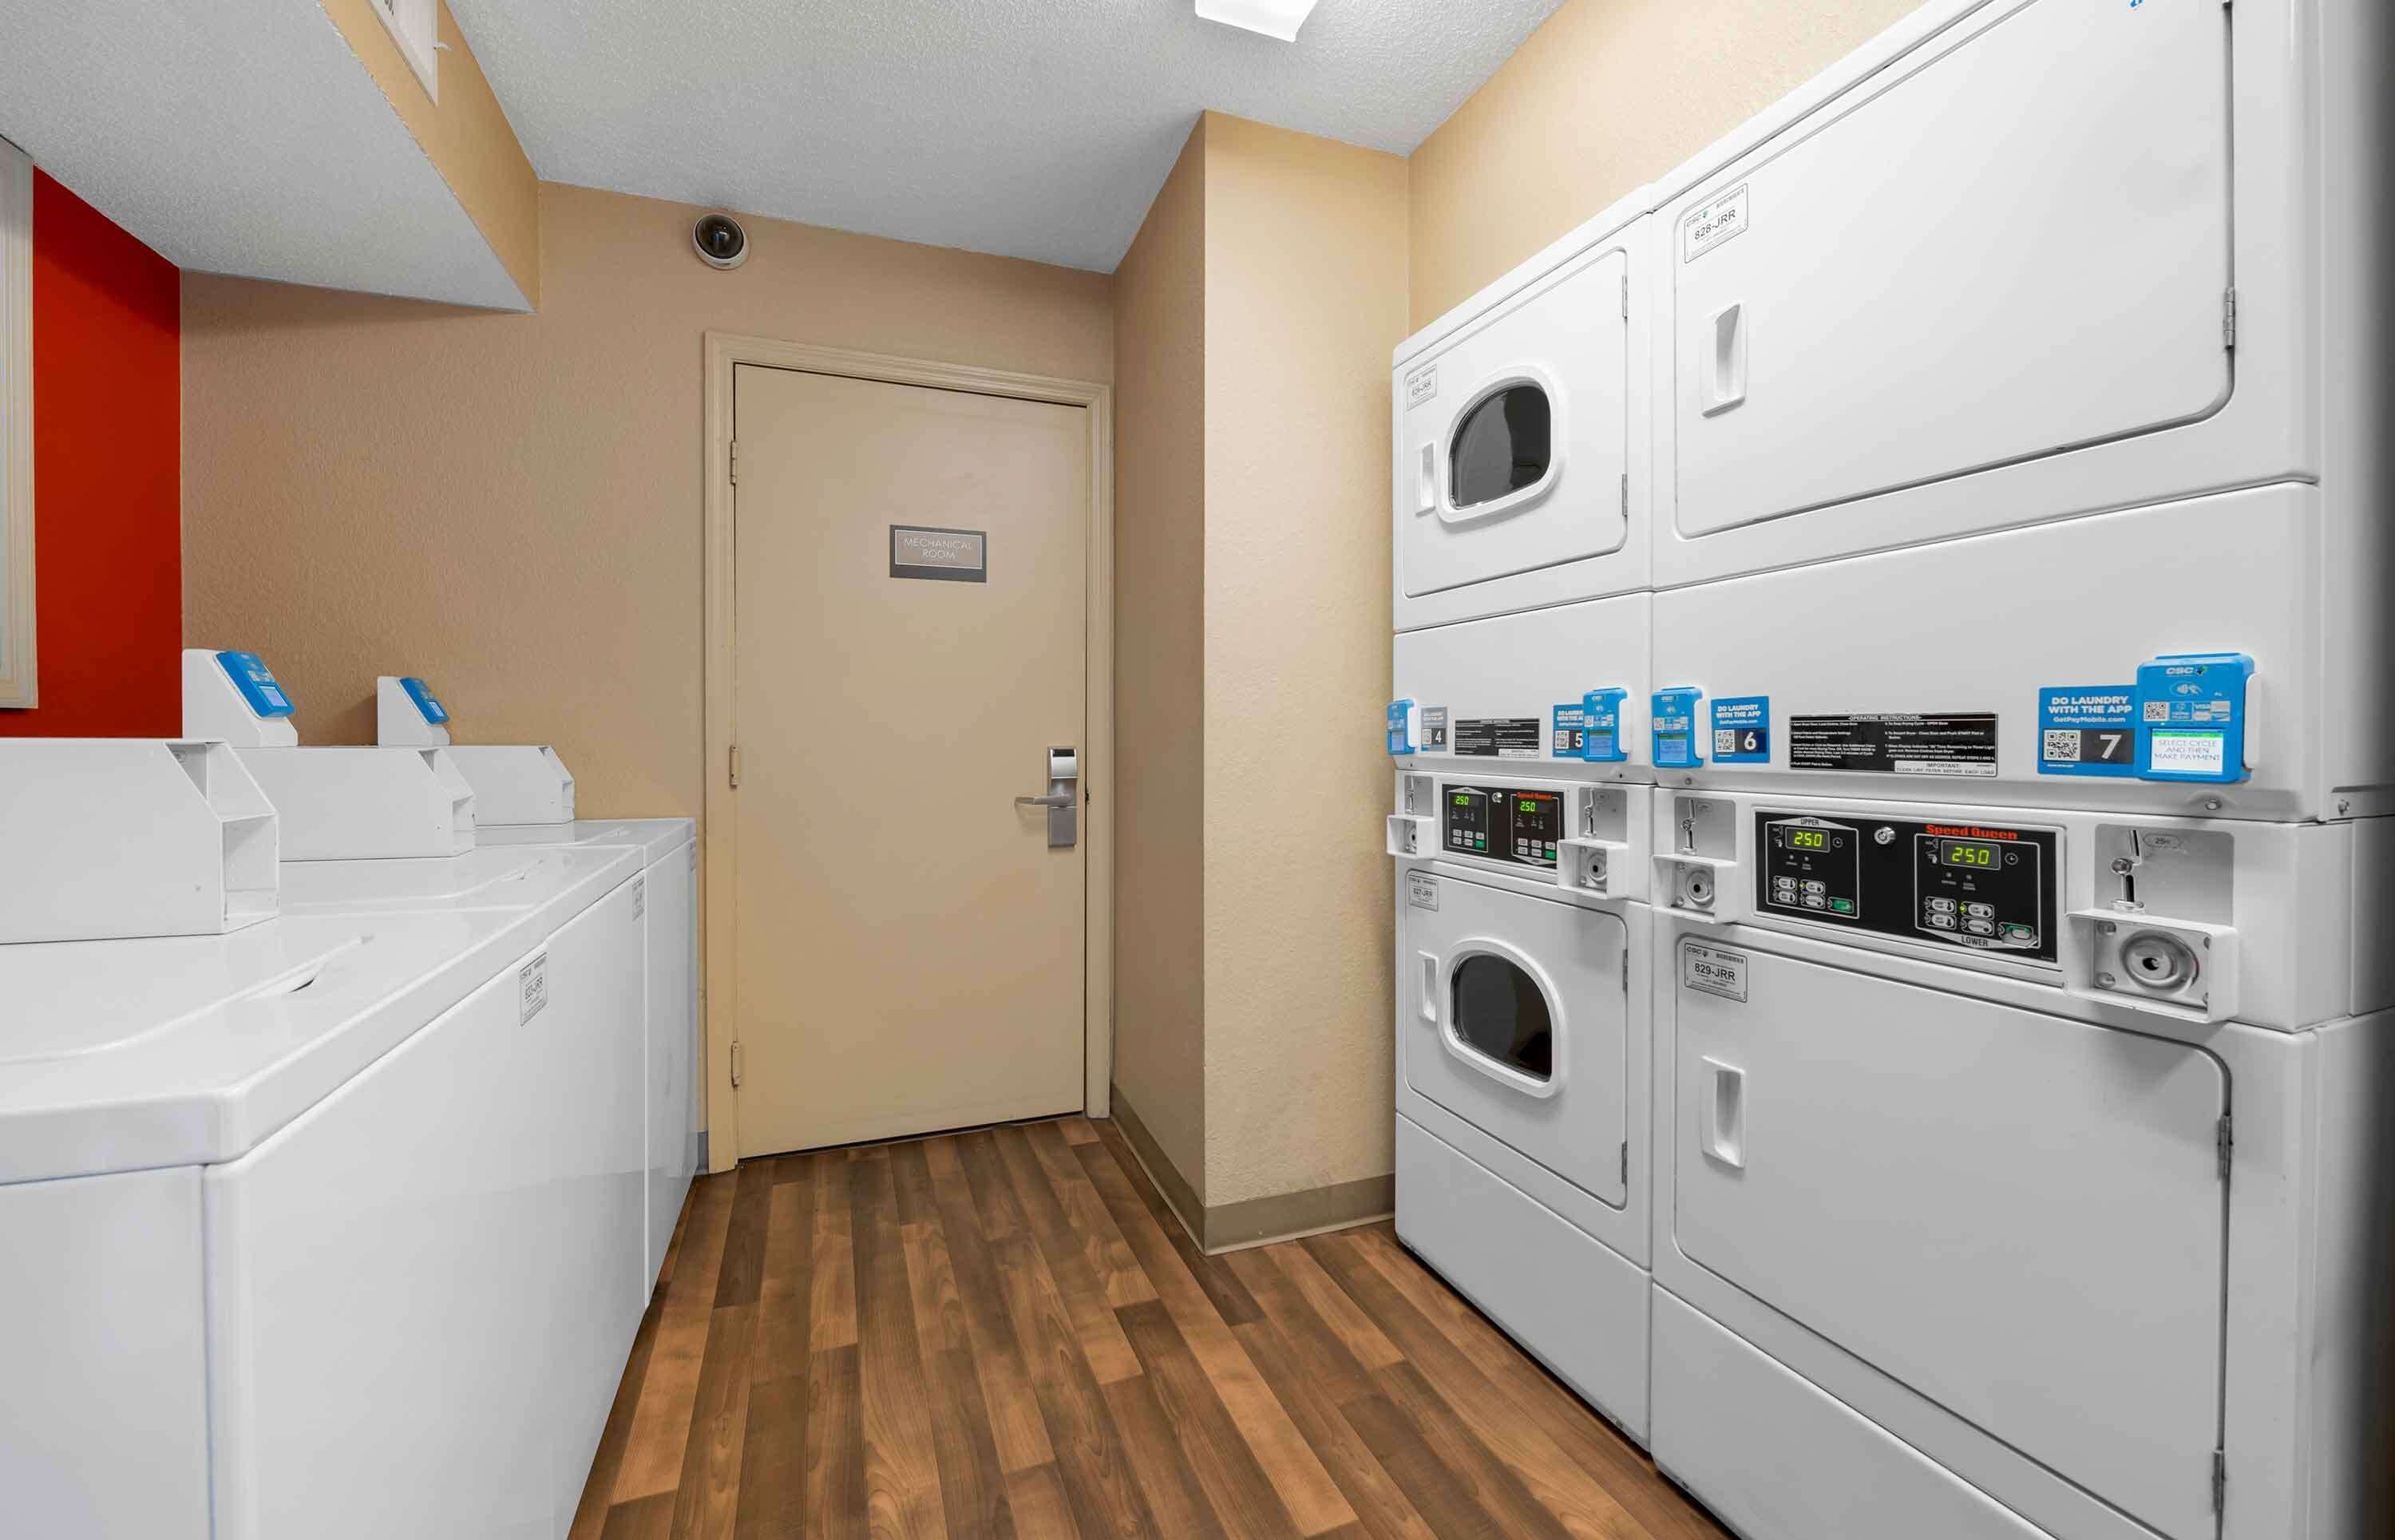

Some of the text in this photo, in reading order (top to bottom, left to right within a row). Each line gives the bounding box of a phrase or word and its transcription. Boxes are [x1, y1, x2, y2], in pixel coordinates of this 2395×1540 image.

[1694, 209, 1736, 240] 828-JRR
[904, 536, 972, 550] MECHANICAL
[922, 548, 956, 560] ROOM
[2071, 695, 2129, 705] LAUNDRY
[2107, 705, 2132, 714] APP
[1435, 730, 1443, 743] 4
[1574, 732, 1584, 748] 5
[1744, 731, 1757, 750] 6
[2099, 734, 2123, 759] 7
[1455, 795, 1470, 806] 250
[1520, 801, 1536, 812] 250
[1794, 831, 1823, 847] 250
[1925, 823, 2018, 841] Speed Queen
[1951, 847, 1989, 865] 250
[1961, 935, 1989, 947] LOWER
[1694, 962, 1736, 982] 829-JRR
